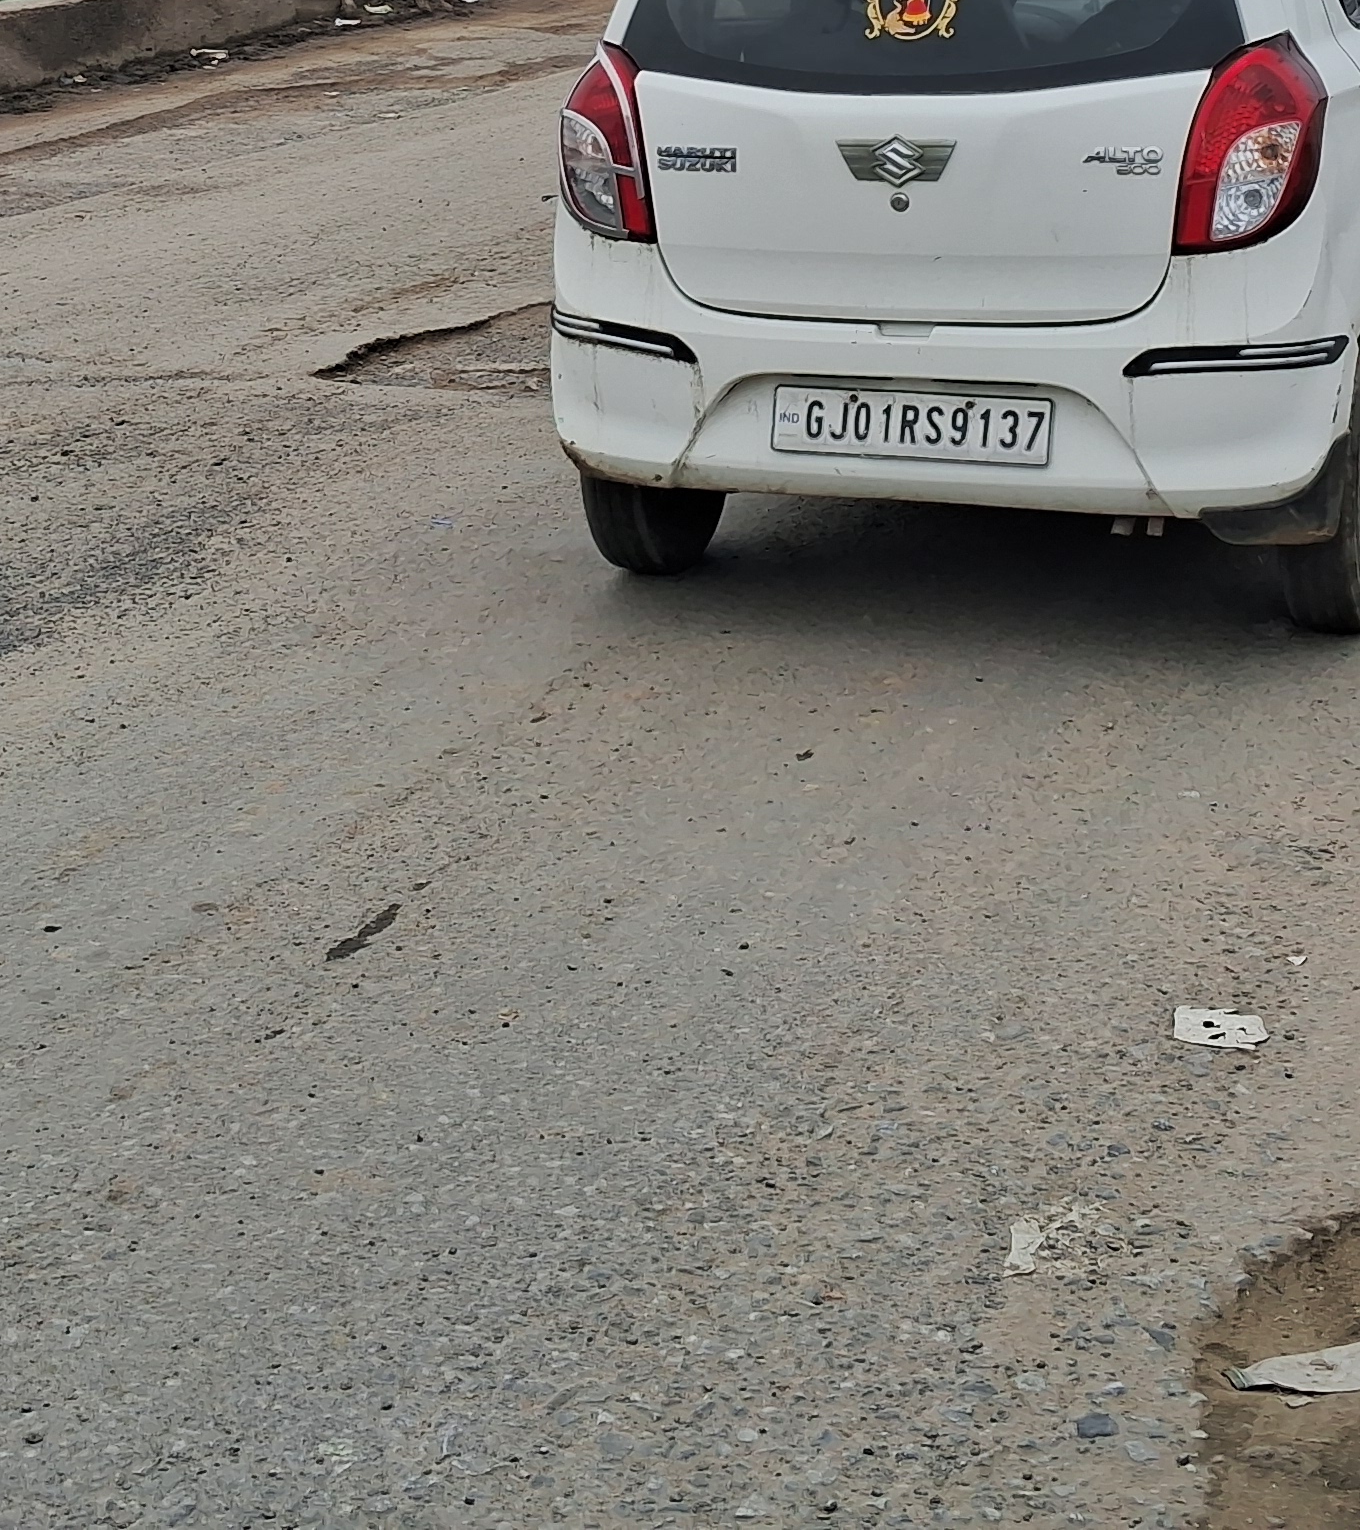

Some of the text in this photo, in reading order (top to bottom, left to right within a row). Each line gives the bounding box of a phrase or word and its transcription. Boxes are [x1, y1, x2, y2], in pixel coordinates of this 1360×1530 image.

[656, 146, 737, 159] MARUTI
[1082, 146, 1164, 164] ALTO
[657, 157, 737, 173] SUZUKI
[778, 399, 1046, 453] IND GJ01RS9137
